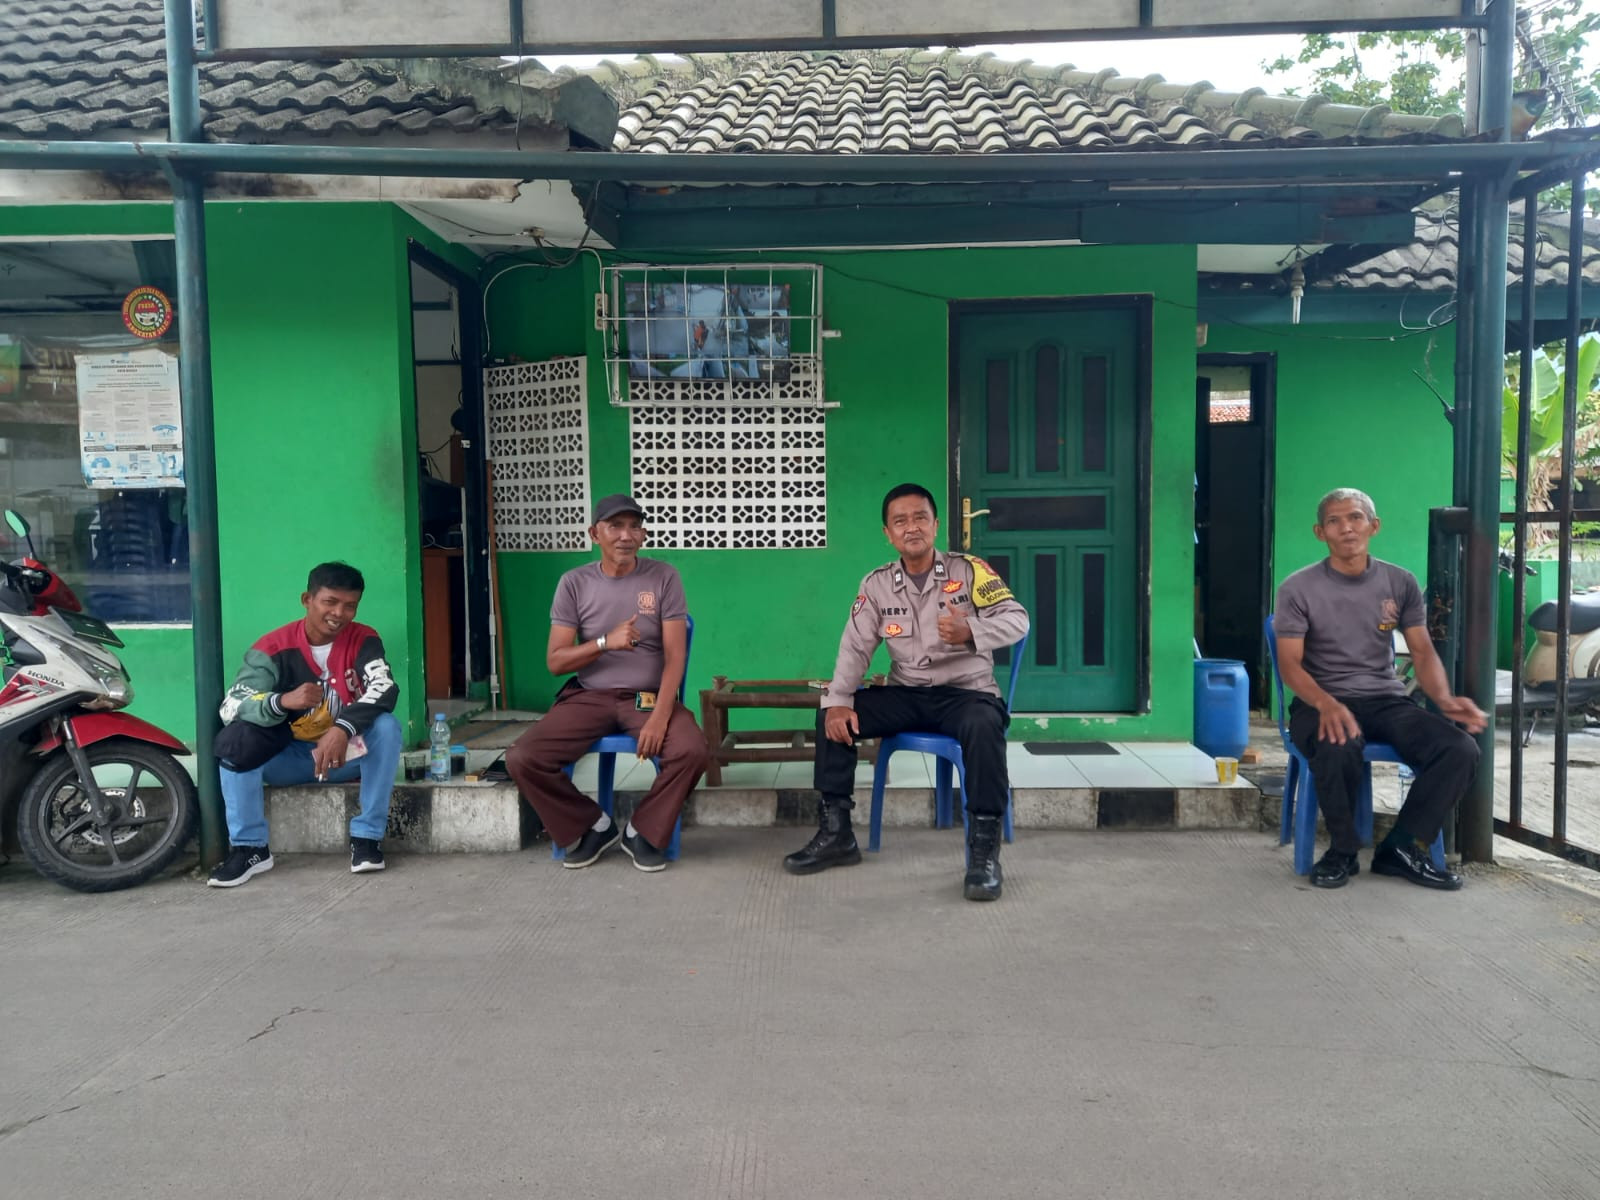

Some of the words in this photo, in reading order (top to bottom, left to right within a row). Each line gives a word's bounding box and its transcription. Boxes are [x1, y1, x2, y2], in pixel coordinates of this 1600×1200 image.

[938, 594, 968, 609] PLRI
[881, 608, 908, 616] HERY
[28, 670, 65, 687] HONDA
